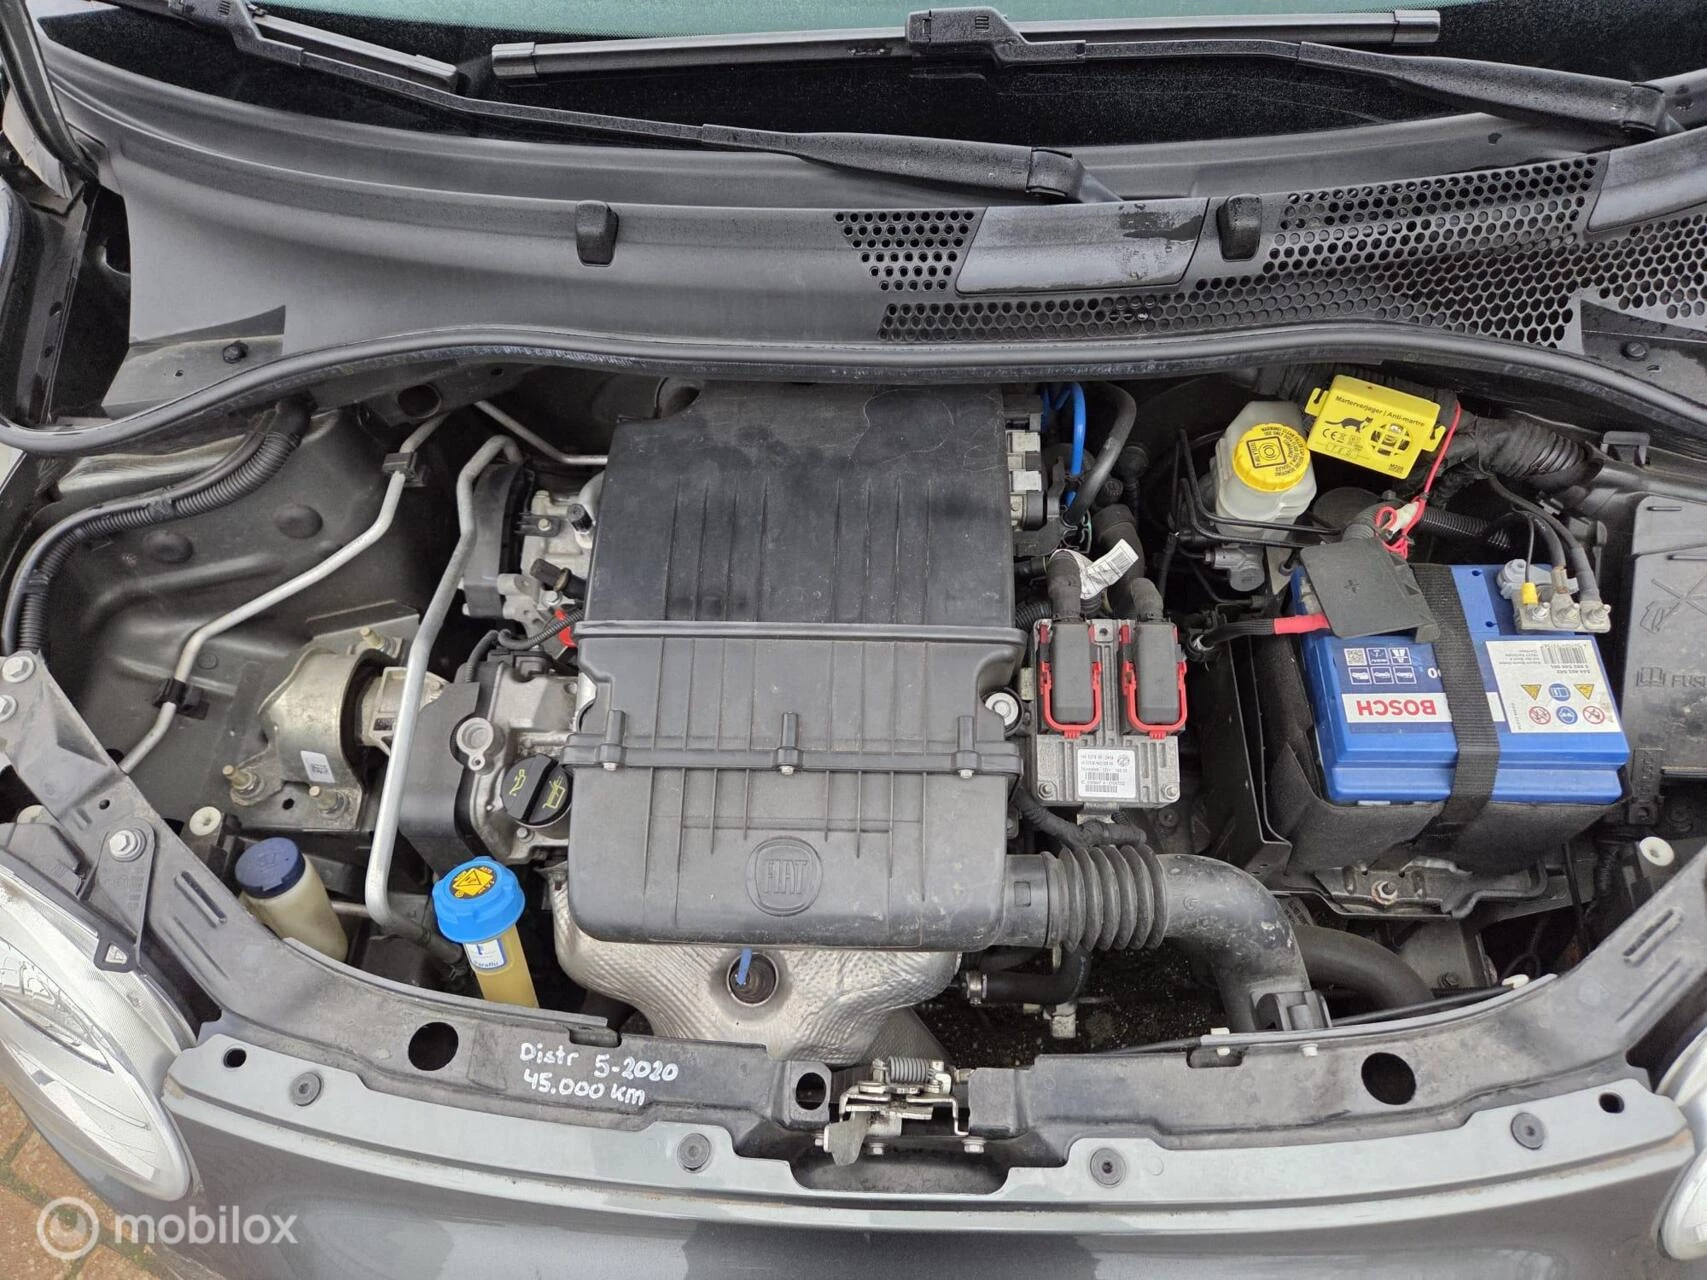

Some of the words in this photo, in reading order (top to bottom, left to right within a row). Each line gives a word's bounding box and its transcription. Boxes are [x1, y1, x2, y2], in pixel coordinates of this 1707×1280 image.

[1335, 395, 1383, 414] Marterverjager
[1356, 699, 1437, 716] BOSCH
[763, 858, 809, 895] FIAT
[519, 1043, 579, 1066] Distr
[594, 1054, 679, 1081] 5-2020
[523, 1068, 606, 1099] 45.000
